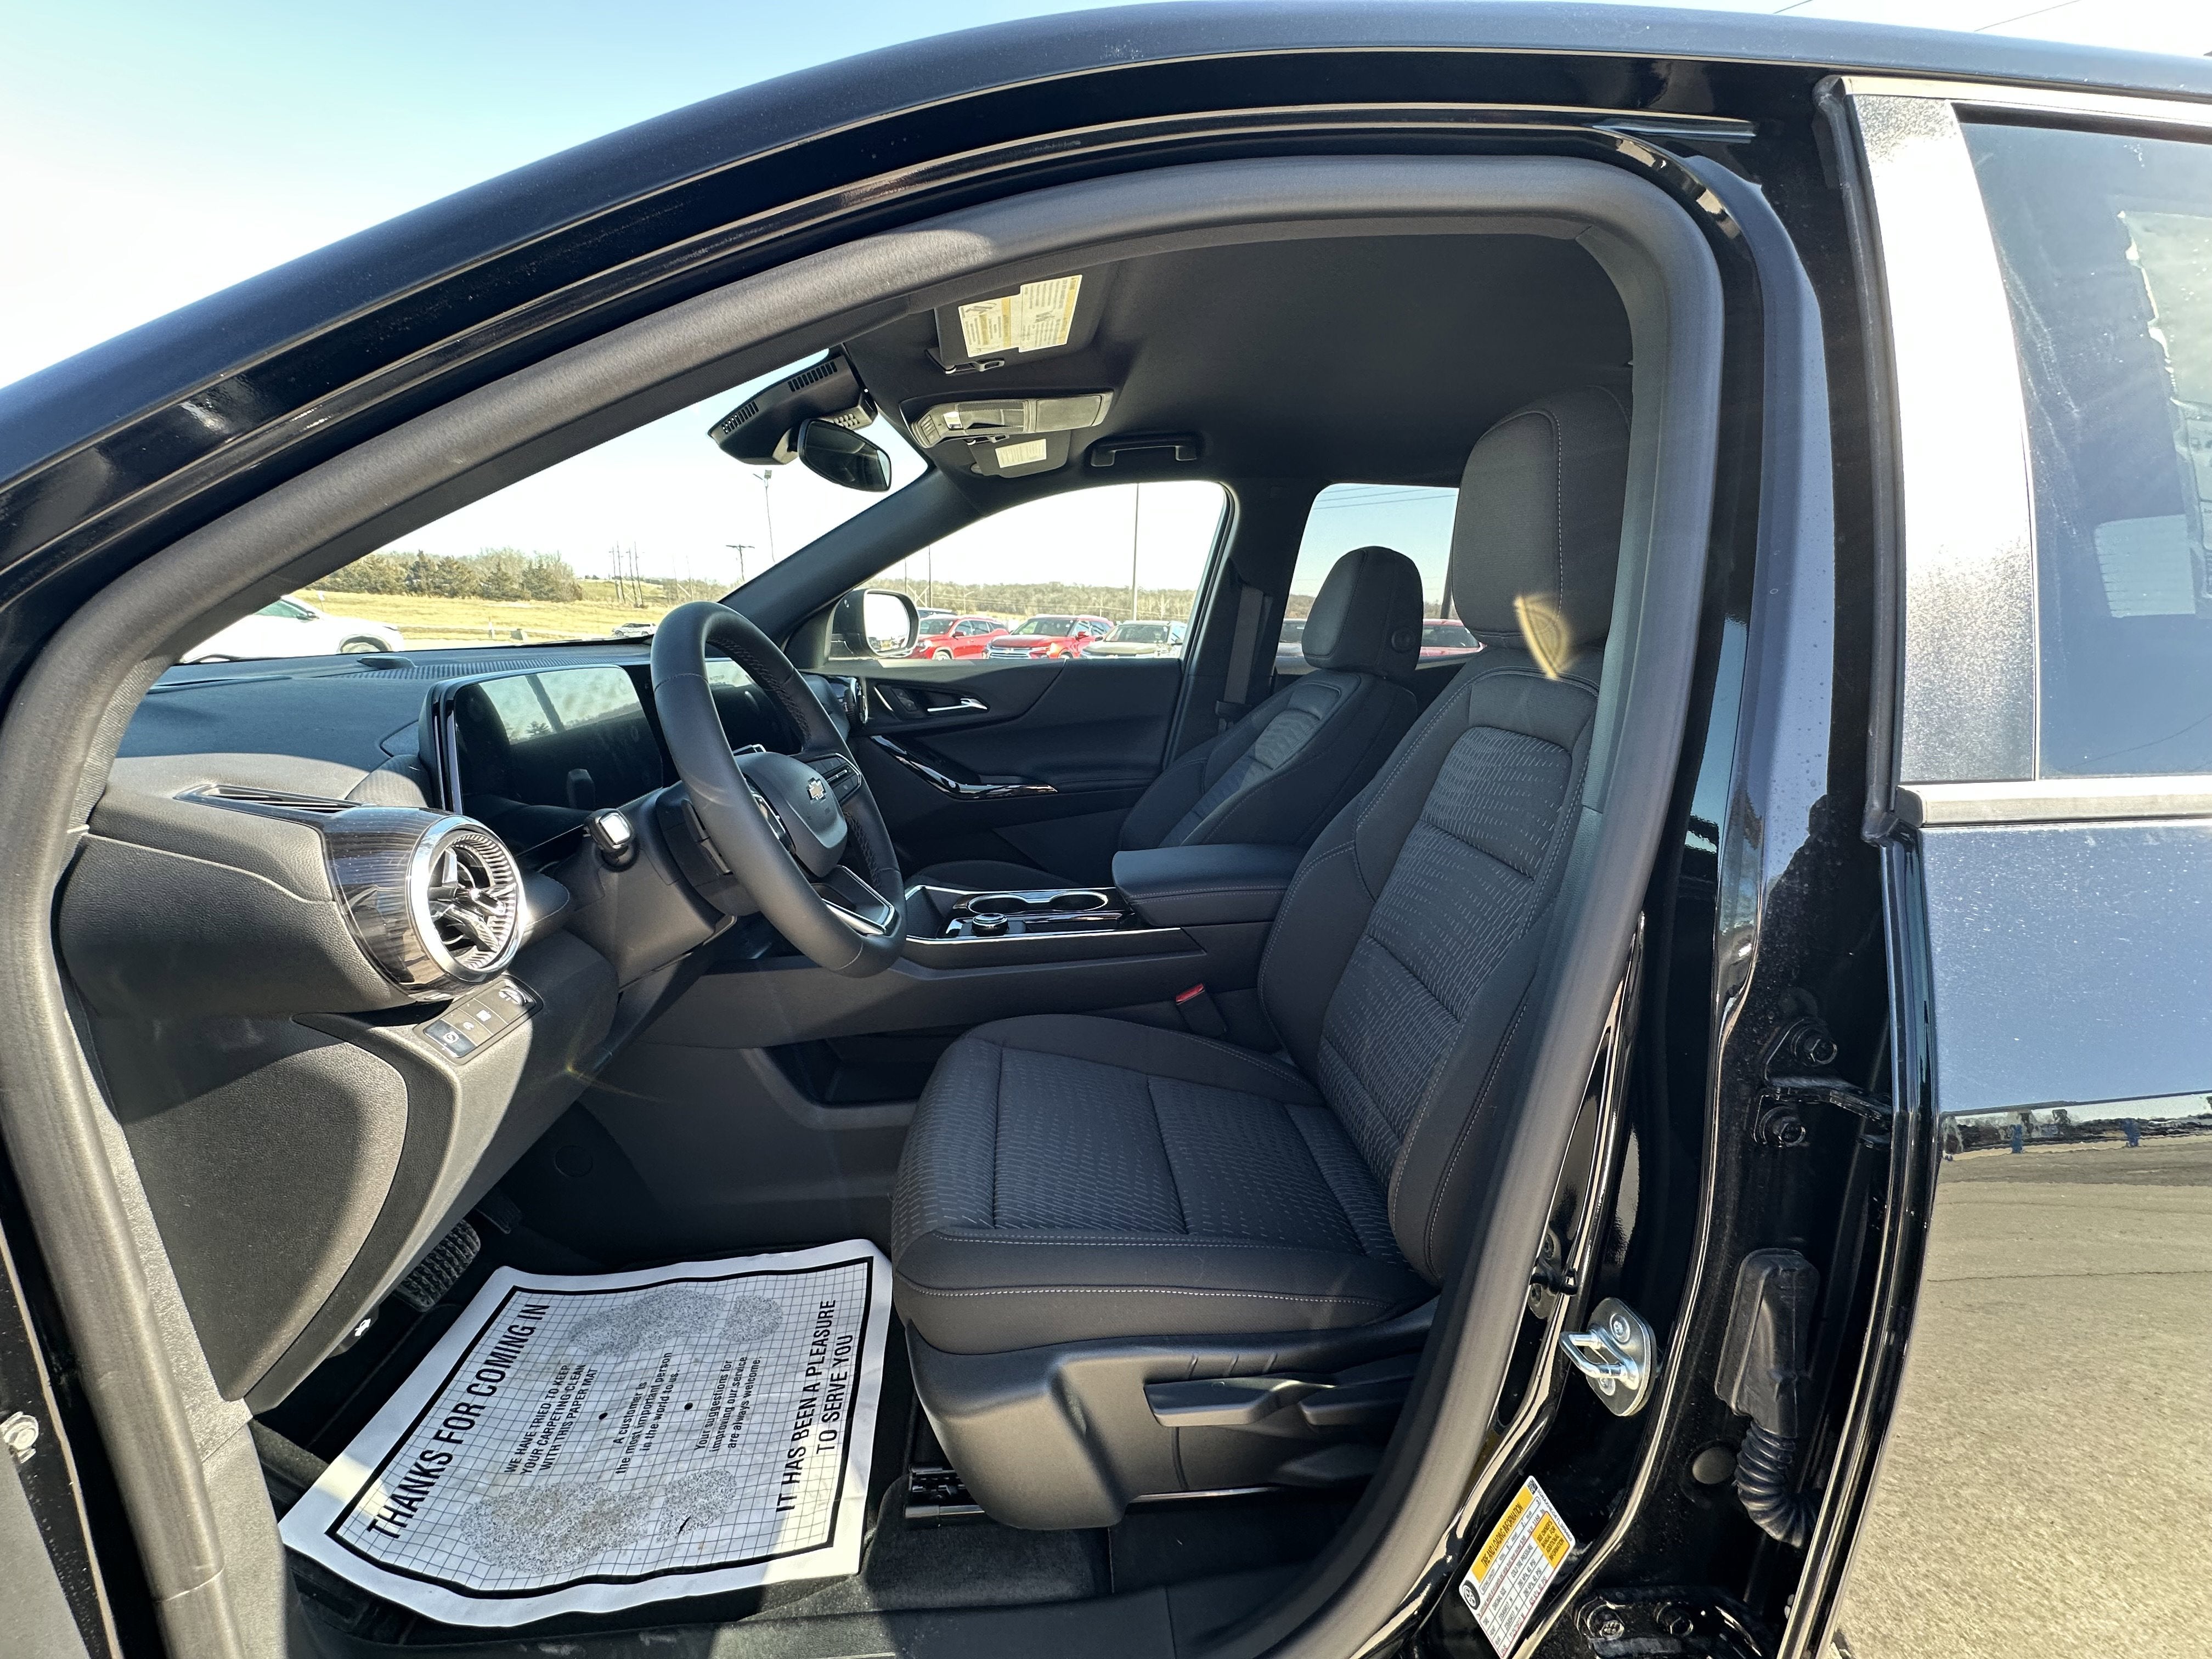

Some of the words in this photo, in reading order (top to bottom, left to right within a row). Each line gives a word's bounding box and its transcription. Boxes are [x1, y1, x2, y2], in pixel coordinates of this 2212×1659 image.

[805, 1299, 836, 1378] PLEASURE
[833, 1334, 853, 1367] YOU
[662, 1385, 674, 1393] to
[669, 1370, 680, 1383] us.
[732, 1356, 747, 1387] service
[743, 1356, 761, 1398] welcome.
[803, 1382, 820, 1392] A
[615, 1458, 630, 1474] the
[625, 1430, 642, 1454] most
[634, 1385, 661, 1429] important
[654, 1353, 672, 1383] person
[619, 1393, 643, 1434] customer
[653, 1396, 670, 1421] world
[695, 1430, 710, 1450] Your
[705, 1374, 728, 1427] suggestions
[721, 1360, 732, 1372] for
[727, 1389, 738, 1404] our
[732, 1400, 750, 1431] always
[823, 1371, 848, 1423] SERVE
[366, 1450, 453, 1538] THANKS
[433, 1402, 486, 1444] FOR
[466, 1324, 536, 1397] COMING
[517, 1304, 550, 1321] IN
[504, 1458, 522, 1473] WE
[517, 1431, 537, 1455] HAVE
[530, 1403, 551, 1430] TRIED
[545, 1388, 559, 1400] TO
[555, 1364, 571, 1386] KEEP
[520, 1448, 544, 1475] YOUR
[537, 1394, 571, 1446] CARPETING
[567, 1364, 586, 1391] CLEAN
[539, 1443, 561, 1471] WITH
[554, 1421, 573, 1443] THIS
[566, 1389, 589, 1419] PAPER
[582, 1368, 598, 1387] MAT
[645, 1424, 659, 1438] the
[709, 1407, 735, 1452] improving
[791, 1396, 817, 1441] BEEN
[639, 1442, 652, 1451] in
[727, 1433, 740, 1448] are
[816, 1430, 838, 1454] TO
[781, 1446, 806, 1485] HAS
[776, 1493, 797, 1513] IT
[1481, 1553, 1489, 1568] TIRE
[1486, 1544, 1495, 1559] AND
[1491, 1527, 1506, 1551] LOADING
[1502, 1502, 1523, 1533] INFORMATION
